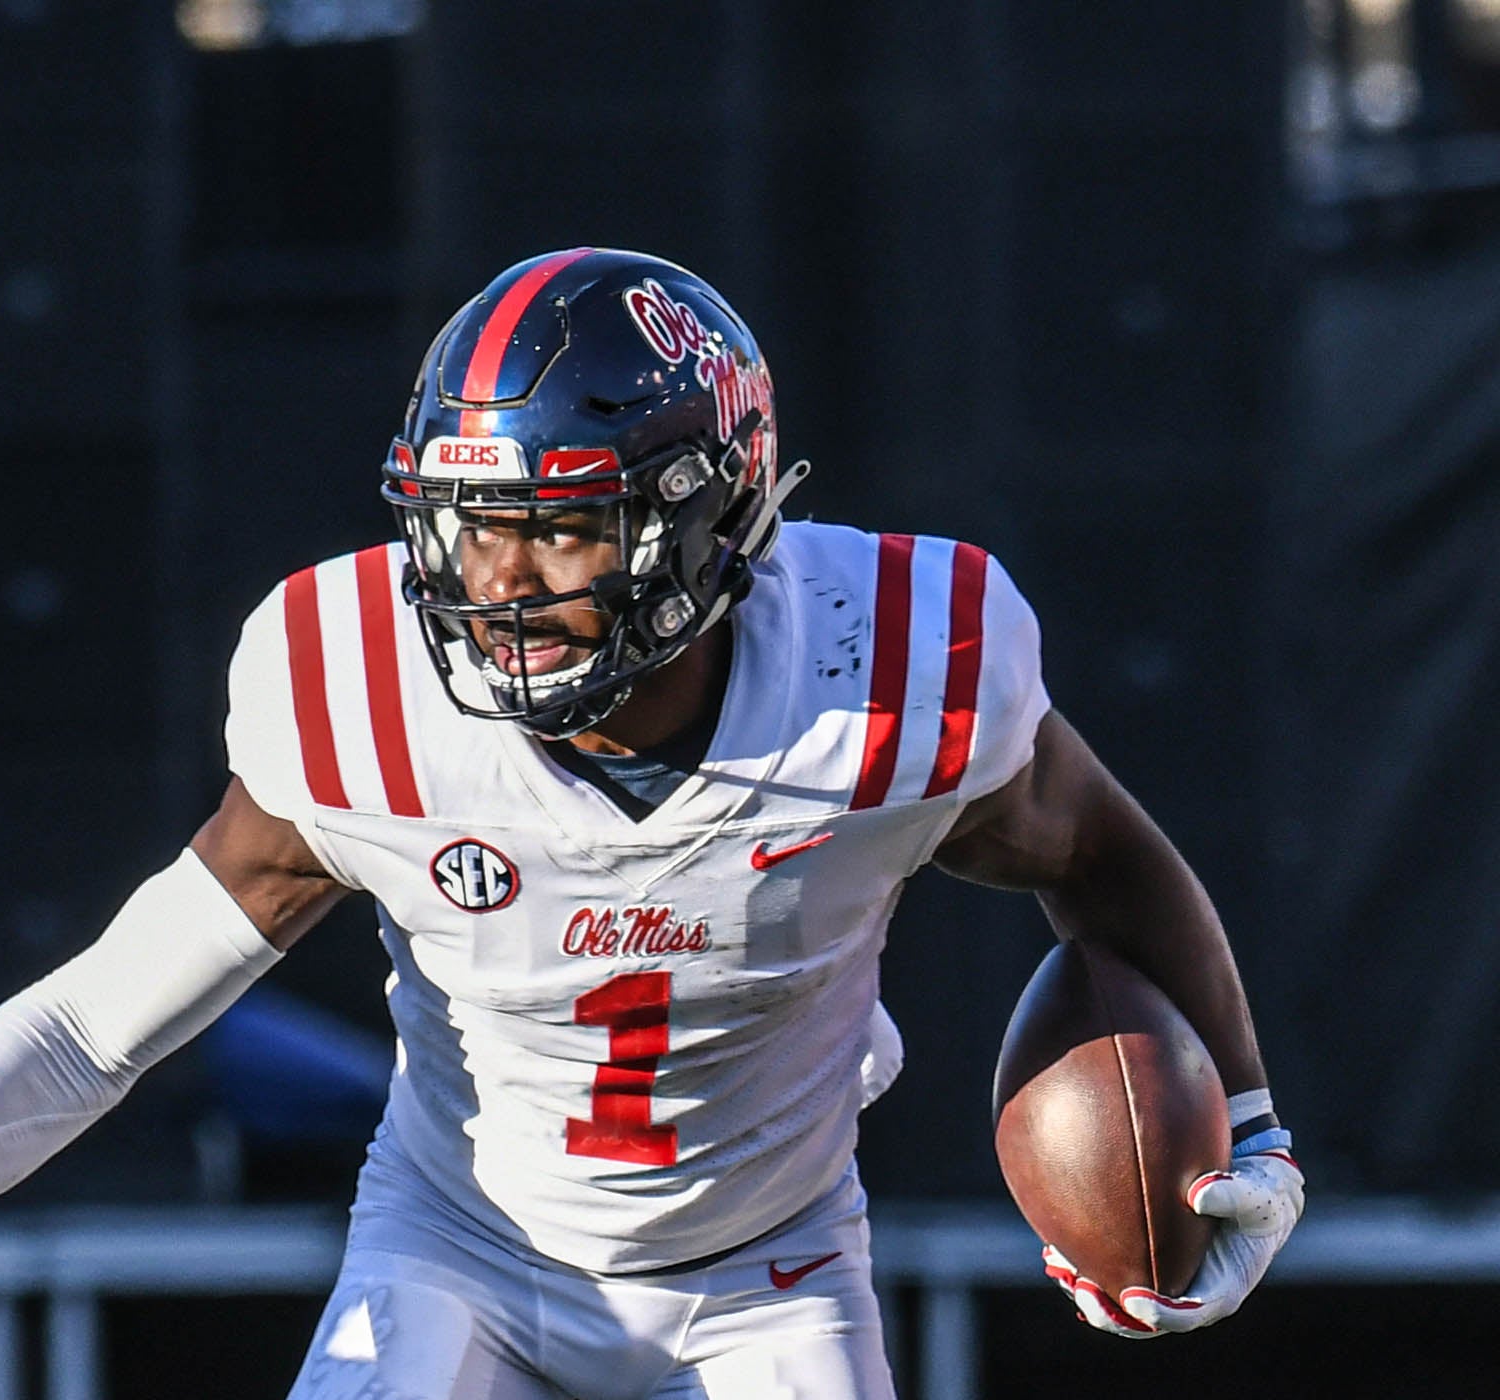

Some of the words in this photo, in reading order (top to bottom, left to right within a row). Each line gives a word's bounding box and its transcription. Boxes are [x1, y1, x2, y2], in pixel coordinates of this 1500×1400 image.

[622, 278, 708, 364] Ole
[439, 444, 499, 466] REBS
[434, 844, 510, 908] SEC
[559, 905, 621, 957] Ole
[621, 903, 713, 956] Miss
[565, 970, 678, 1166] 1
